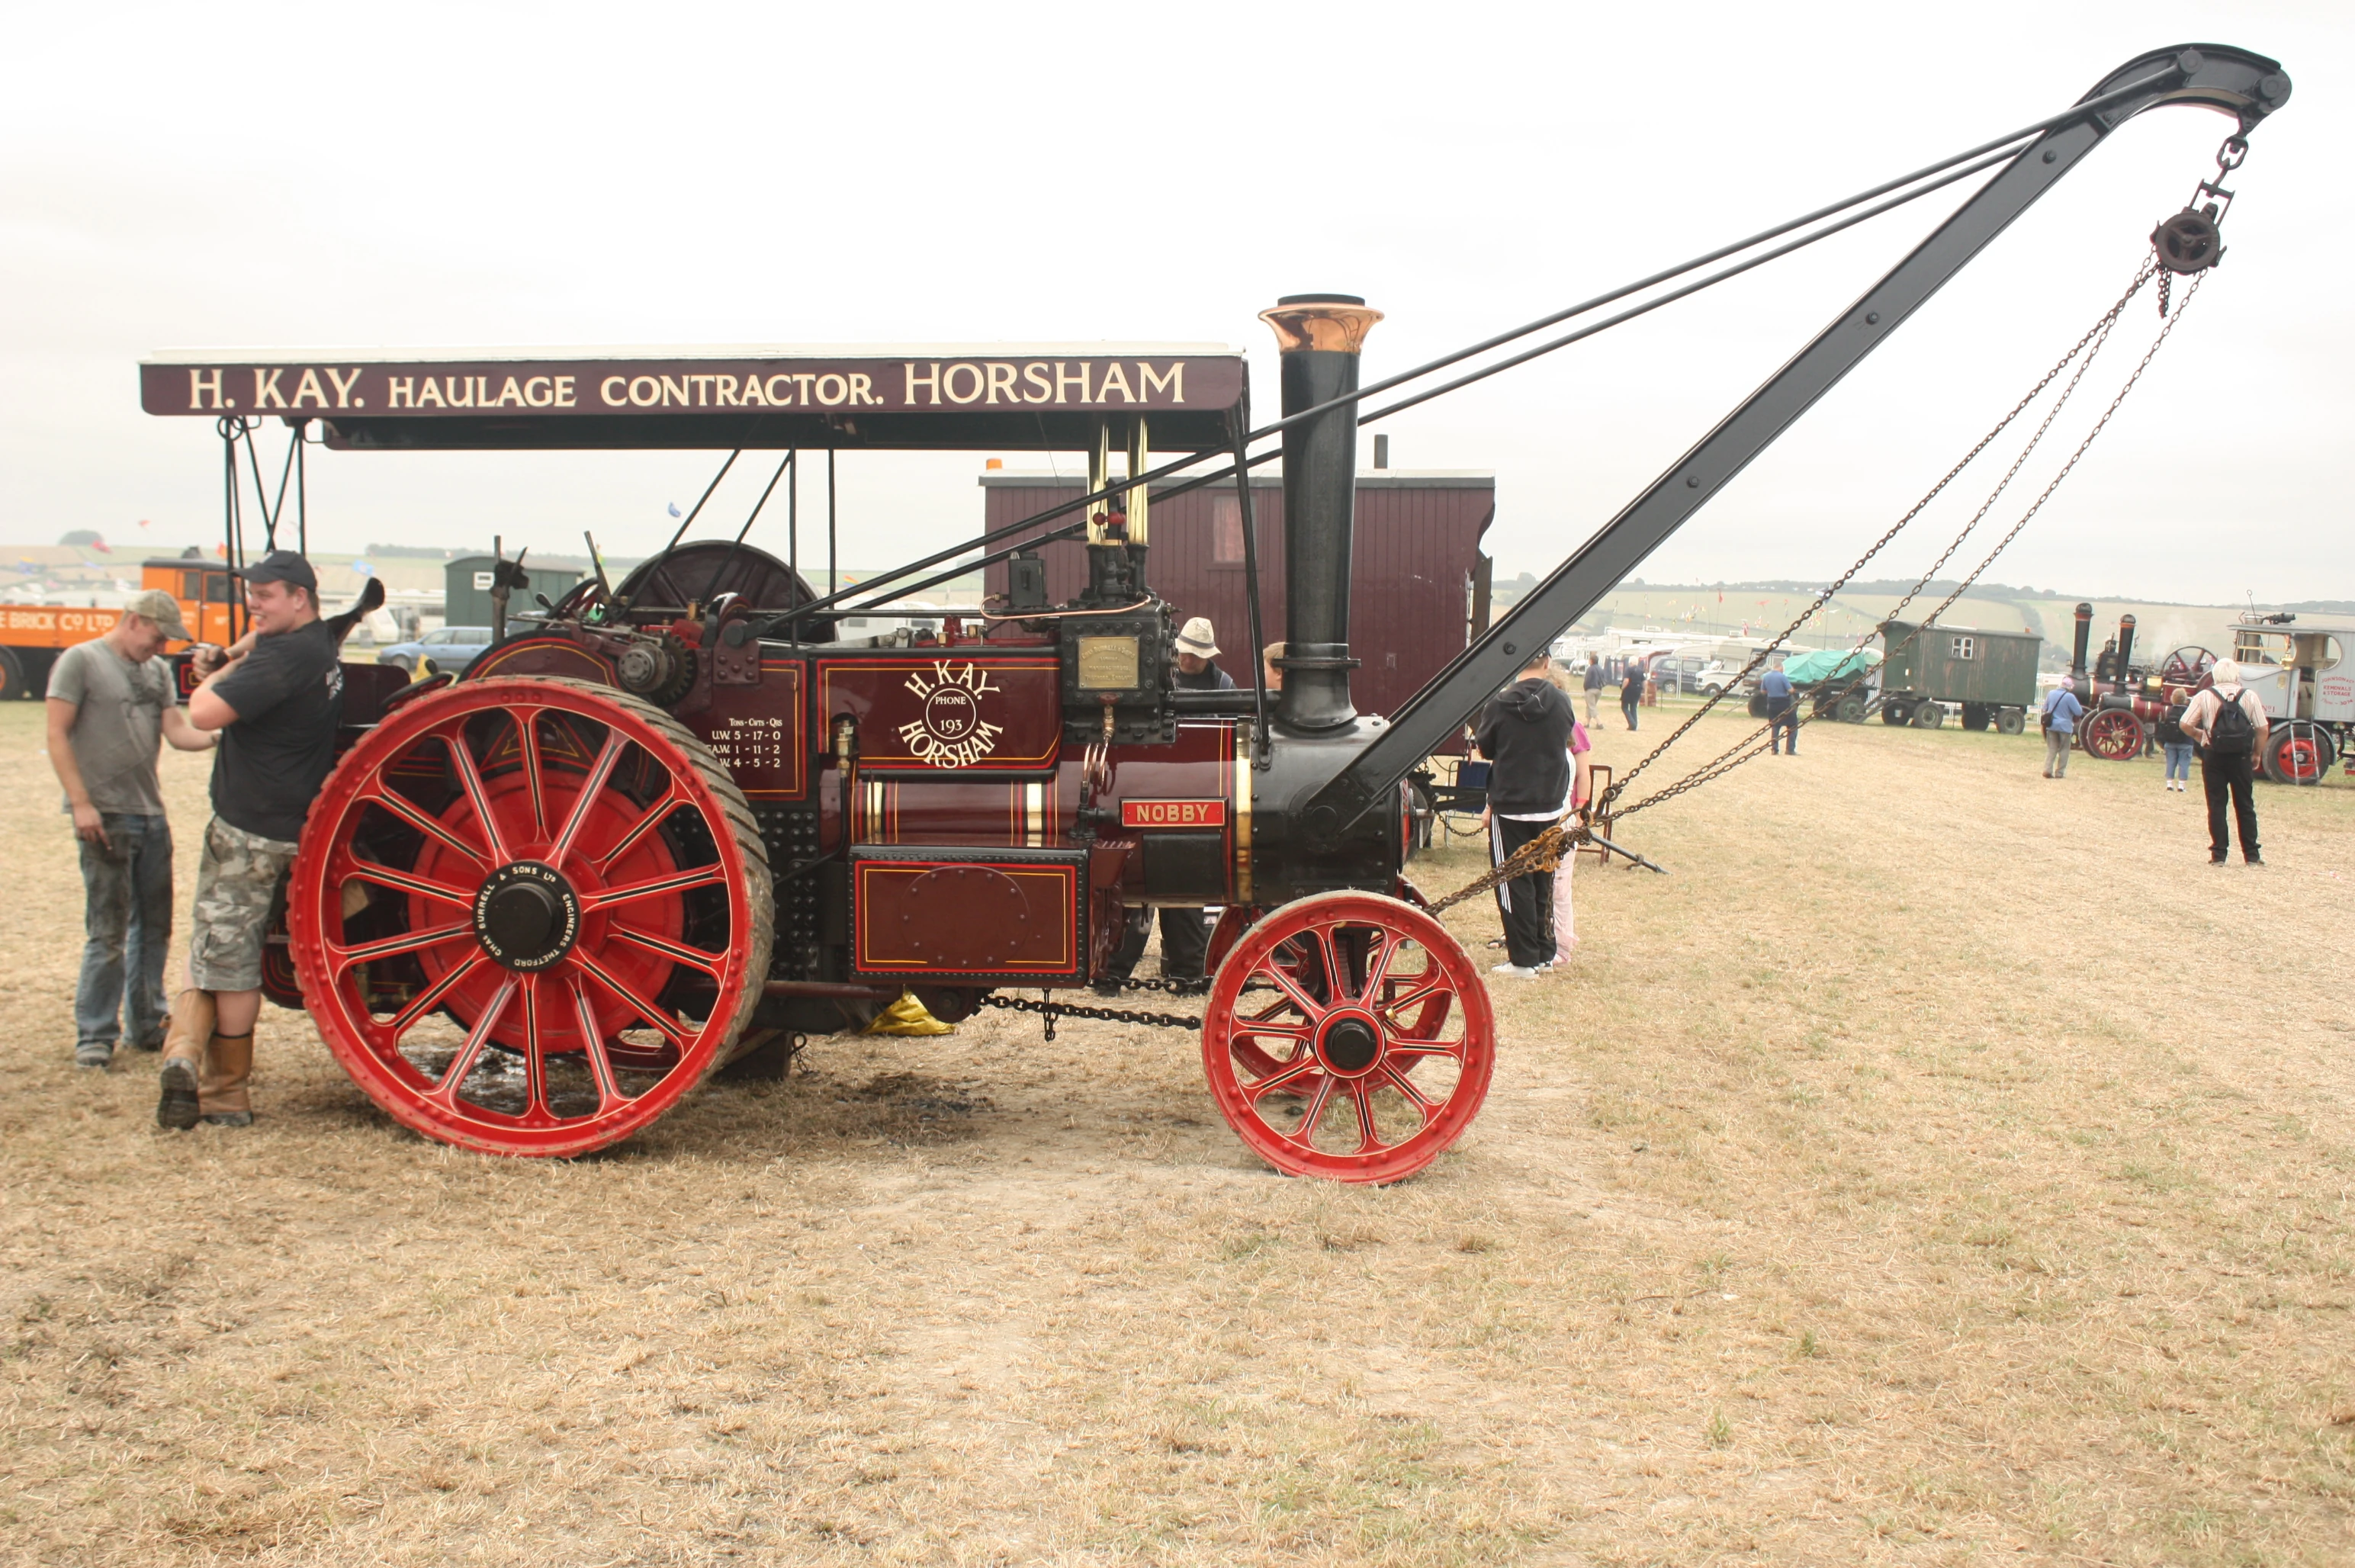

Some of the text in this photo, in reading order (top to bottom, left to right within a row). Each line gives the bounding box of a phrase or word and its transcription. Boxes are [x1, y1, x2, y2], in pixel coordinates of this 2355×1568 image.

[189, 362, 1185, 409] H. KAY. HAULAGE CONTRACTOR. HORSHAM
[9, 612, 56, 630] BRICK
[935, 696, 966, 705] PHONE
[940, 719, 962, 734] 193
[734, 731, 741, 740] 5
[753, 731, 763, 741] 17
[898, 720, 1003, 769] HORSHAM
[753, 745, 761, 754] 11
[773, 744, 780, 754] 2
[734, 758, 741, 767] 4
[753, 758, 760, 767] 5
[773, 758, 780, 768] 2
[1136, 804, 1209, 821] NOBBY
[512, 866, 538, 875] SONS
[477, 883, 496, 930] BURRELL
[559, 893, 575, 947] ENGINEERS
[514, 949, 560, 967] THETFORD
